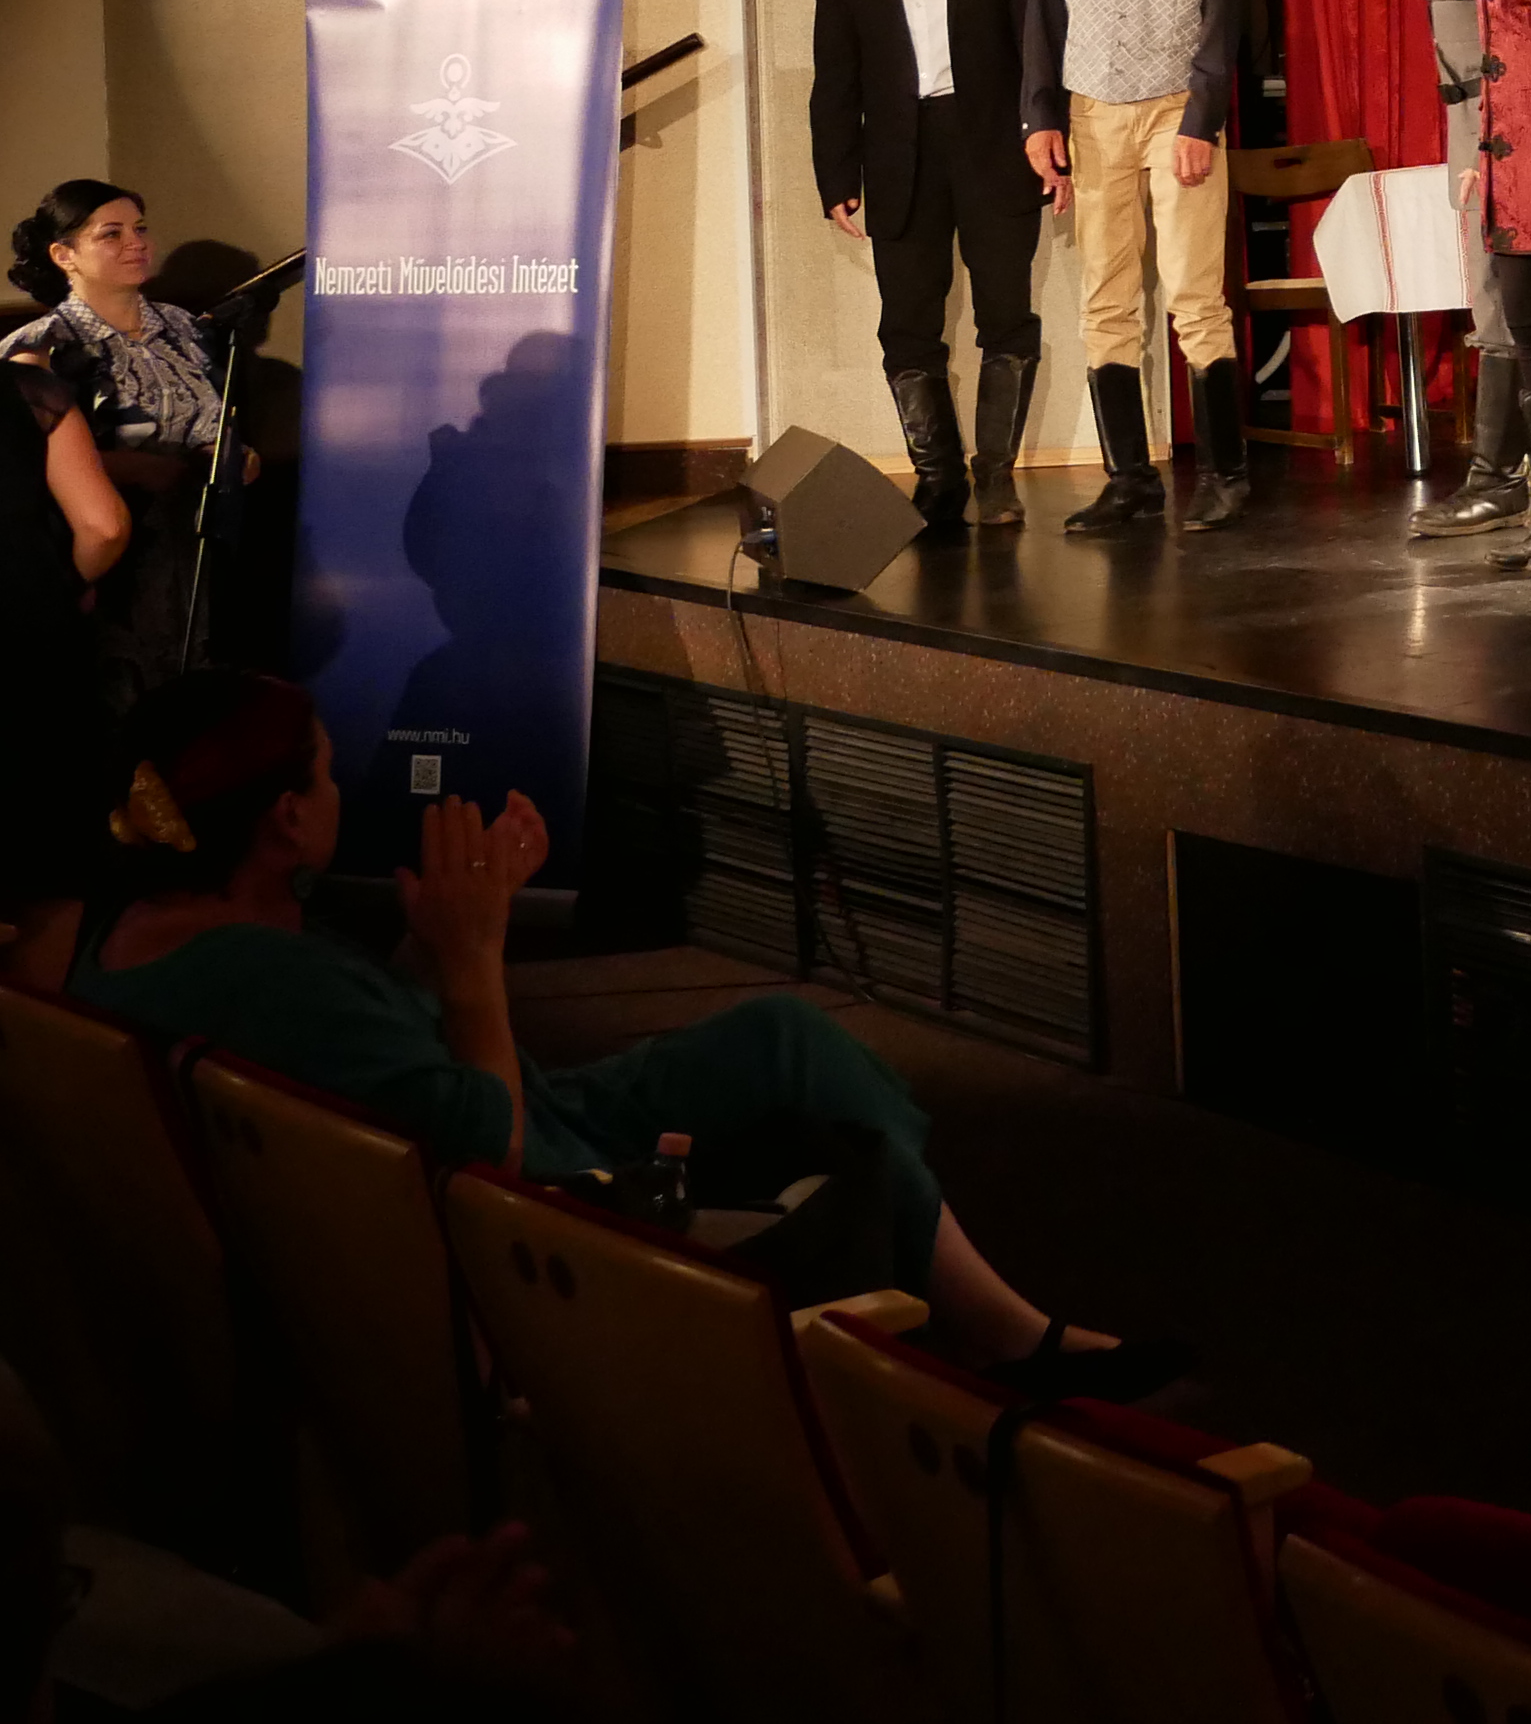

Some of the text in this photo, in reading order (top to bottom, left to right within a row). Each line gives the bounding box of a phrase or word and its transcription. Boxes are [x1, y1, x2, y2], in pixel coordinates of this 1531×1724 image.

[314, 255, 579, 295] Nemzeti Művelődési Intézet
[387, 728, 470, 744] www.nmi.hu
